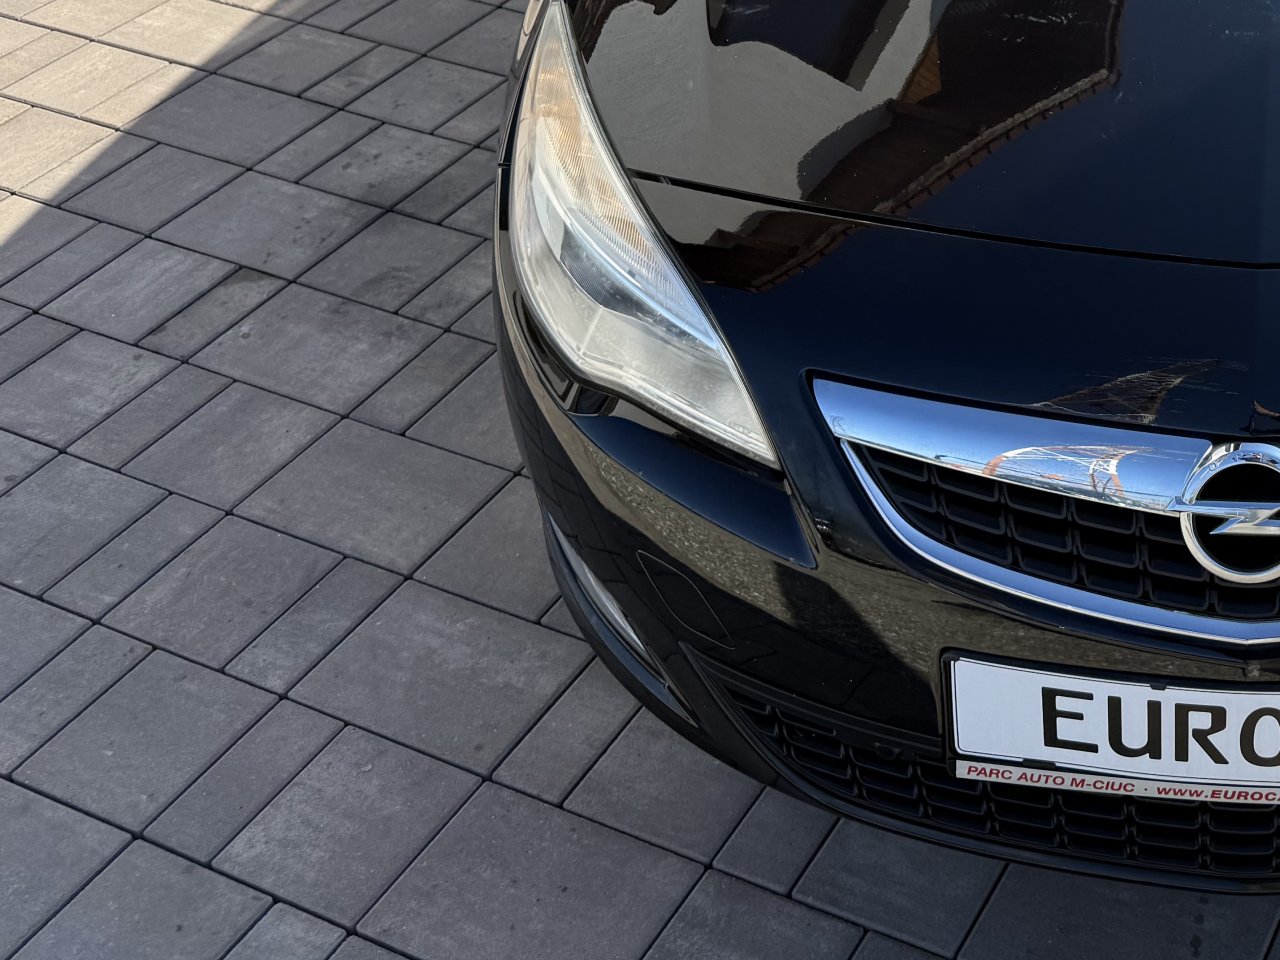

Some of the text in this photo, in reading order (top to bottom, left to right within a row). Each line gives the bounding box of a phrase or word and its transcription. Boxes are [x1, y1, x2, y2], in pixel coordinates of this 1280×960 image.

[966, 765, 1013, 781] PARC
[1016, 771, 1065, 786] AUTO
[1070, 777, 1136, 793] M-CIUC
